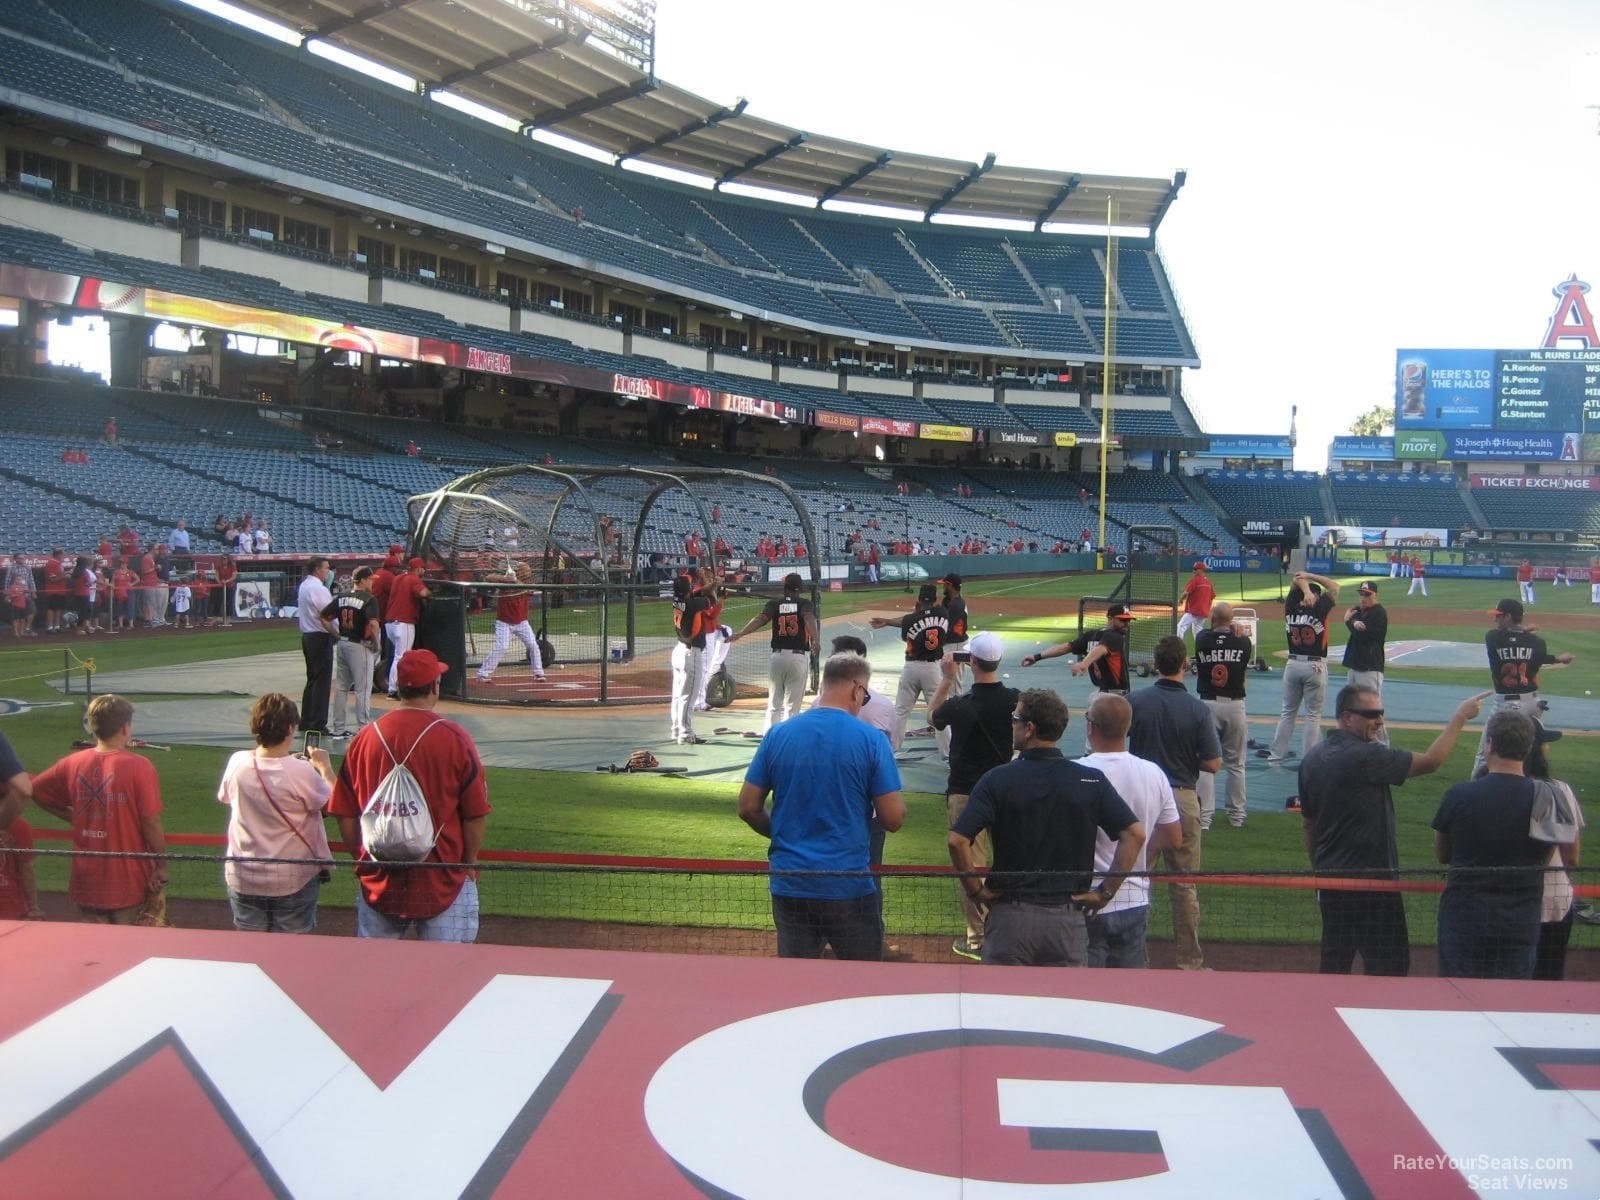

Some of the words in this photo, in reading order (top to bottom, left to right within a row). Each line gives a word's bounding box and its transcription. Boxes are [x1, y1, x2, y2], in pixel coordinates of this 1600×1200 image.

[1530, 351, 1542, 359] NL
[1545, 351, 1570, 359] RUNS
[467, 347, 512, 375] ANGELS
[1503, 364, 1546, 372] A.Rendon
[1431, 370, 1471, 379] HERE'S
[1473, 370, 1491, 379] TO
[613, 373, 651, 398] ANGELS
[1432, 380, 1451, 389] THE
[1454, 380, 1491, 389] HALOS
[1501, 399, 1549, 407] F.Freeman
[1500, 410, 1545, 418] G.Stanton
[818, 413, 838, 425] WELLS
[839, 415, 858, 428] FARGO
[1001, 432, 1017, 442] Yard
[1017, 432, 1037, 443] House
[1401, 442, 1437, 452] more
[1502, 438, 1524, 449] Hoag
[1524, 438, 1552, 448] Health
[1480, 477, 1522, 487] TICKET
[1526, 478, 1590, 489] EXCHANGE
[1242, 521, 1270, 531] JMG
[1203, 555, 1240, 570] Corona
[778, 615, 798, 636] 13
[925, 628, 939, 650] 3
[1496, 647, 1532, 660] YELICH
[1211, 664, 1228, 687] 9
